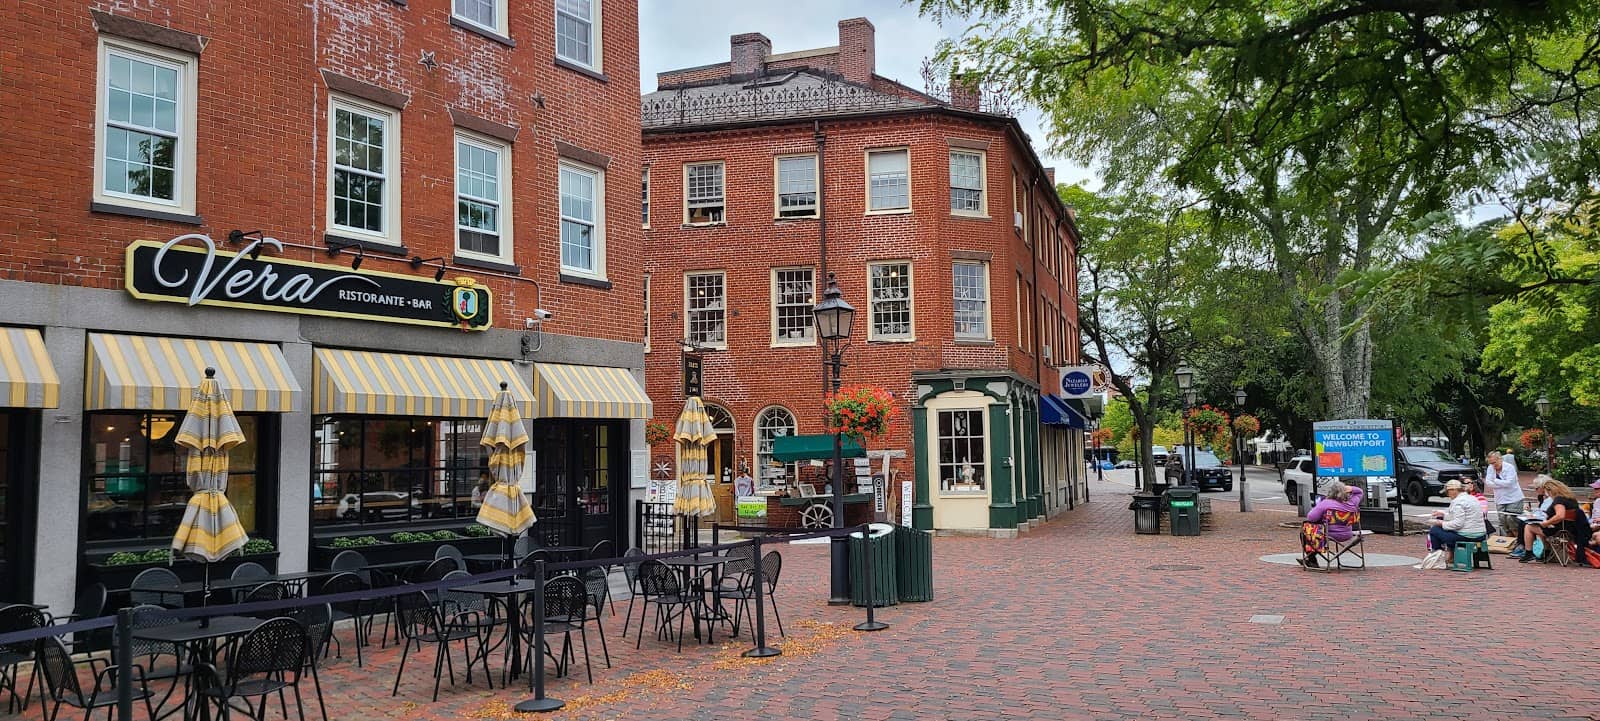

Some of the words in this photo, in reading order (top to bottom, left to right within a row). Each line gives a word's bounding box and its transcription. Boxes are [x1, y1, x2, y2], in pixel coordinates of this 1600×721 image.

[154, 233, 381, 306] Vera
[339, 289, 404, 307] RISTORANTE
[412, 298, 433, 310] BAR
[1322, 433, 1365, 441] WELCOME
[1367, 432, 1380, 440] TO
[1322, 440, 1386, 448] NEWBURYPORT
